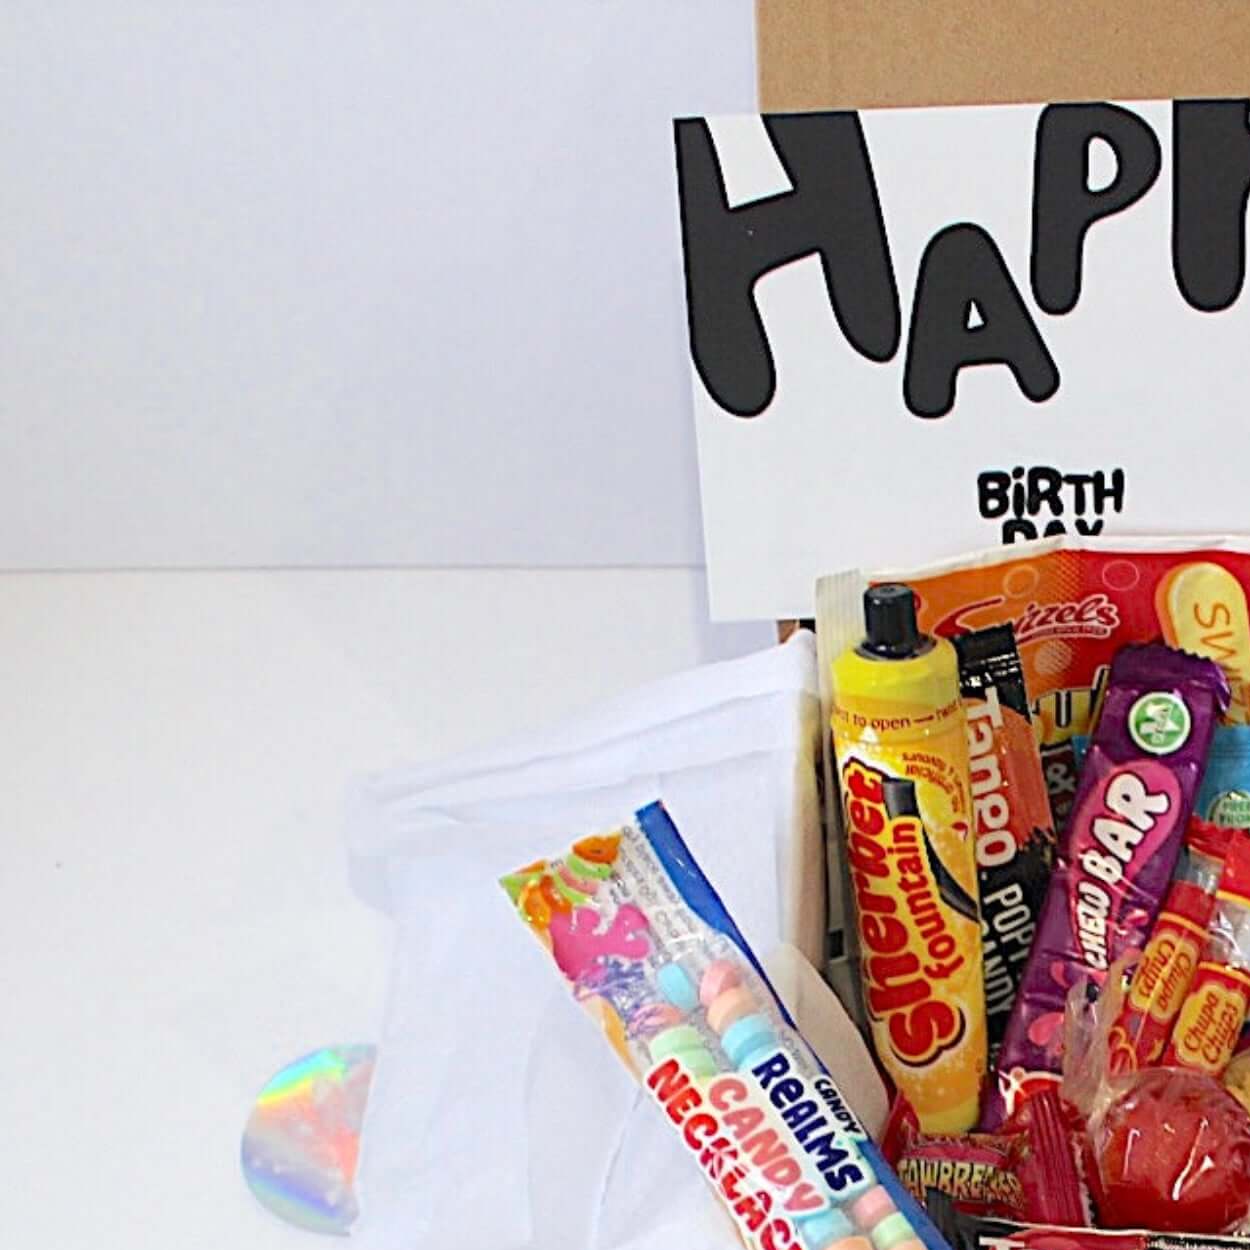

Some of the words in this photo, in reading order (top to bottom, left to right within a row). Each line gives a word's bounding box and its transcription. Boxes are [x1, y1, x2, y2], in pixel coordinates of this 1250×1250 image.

[967, 686, 1017, 867] Tango
[1083, 771, 1170, 882] BAR
[846, 764, 960, 1058] Sherbet
[888, 821, 965, 979] fountain
[1077, 880, 1112, 970] CHEW
[708, 1077, 827, 1212] CANDY
[814, 1078, 862, 1135] CANDY
